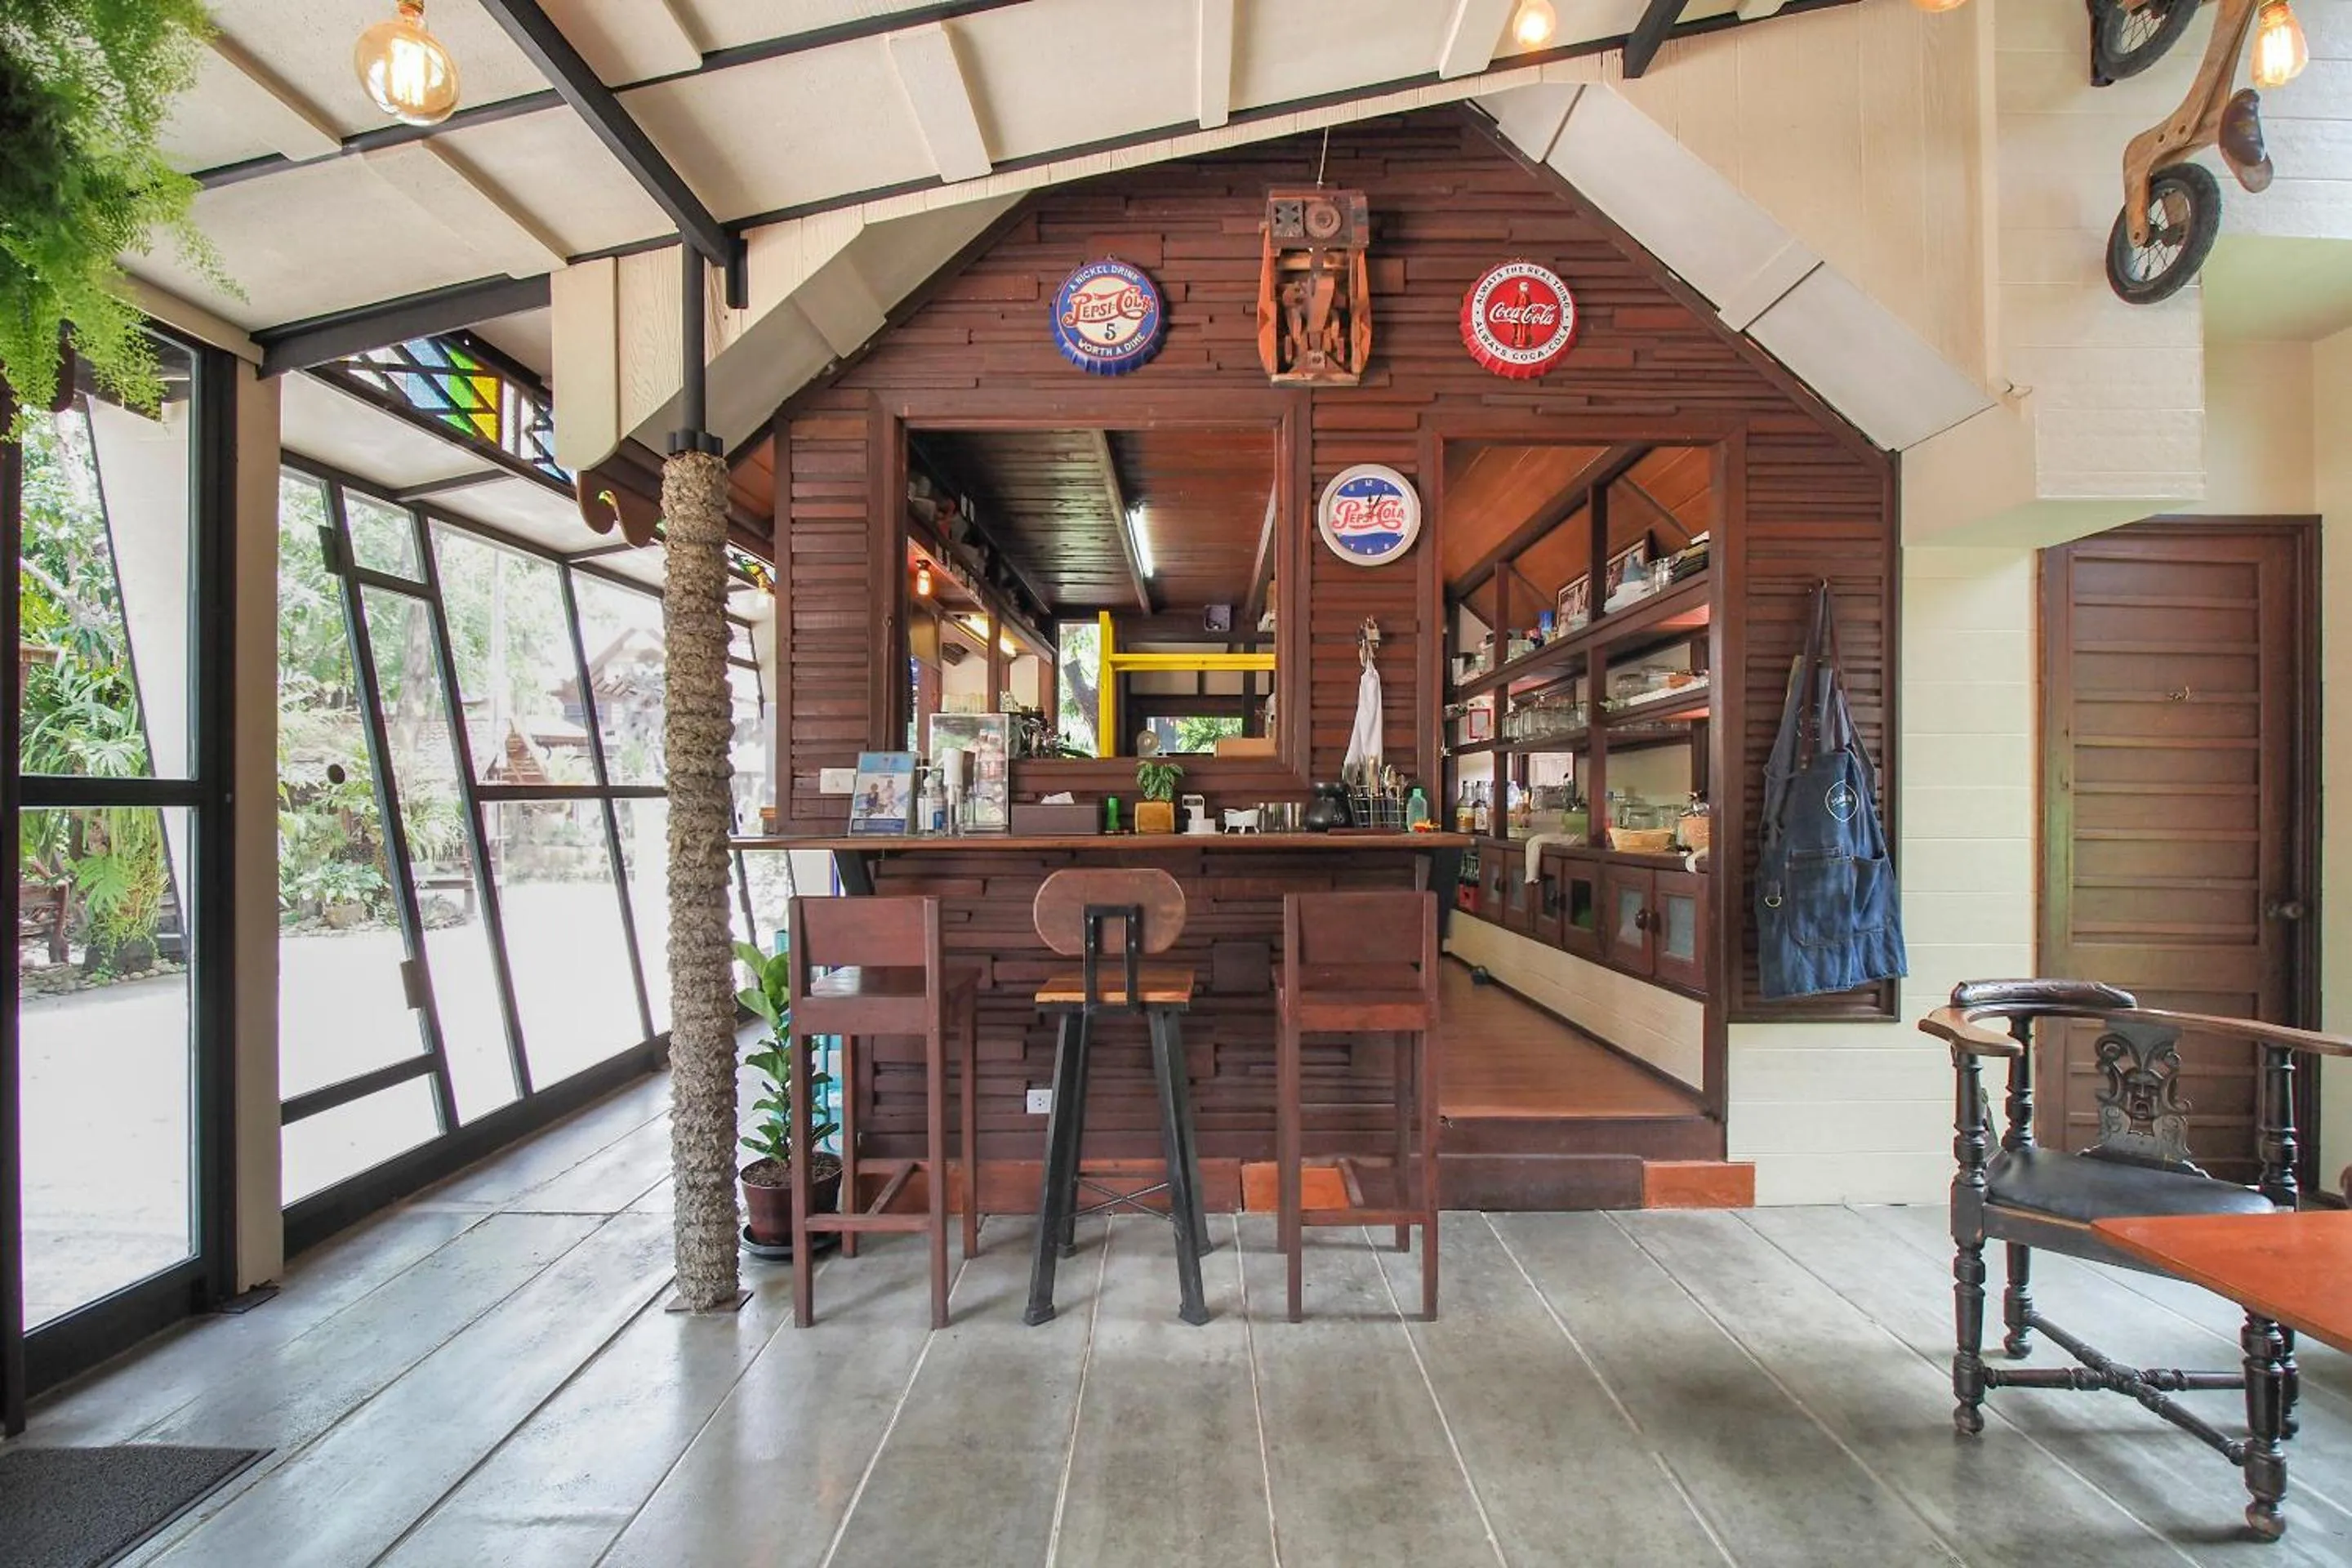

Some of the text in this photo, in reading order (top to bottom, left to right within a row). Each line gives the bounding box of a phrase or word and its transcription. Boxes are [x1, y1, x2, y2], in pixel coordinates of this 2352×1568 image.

[1076, 265, 1107, 283] NICKEL
[1111, 265, 1140, 282] DRINK
[1476, 272, 1503, 305] ALWAYS
[1506, 266, 1525, 274] THE
[1527, 266, 1551, 281] REAL
[1078, 332, 1146, 356] WORTH A DIME
